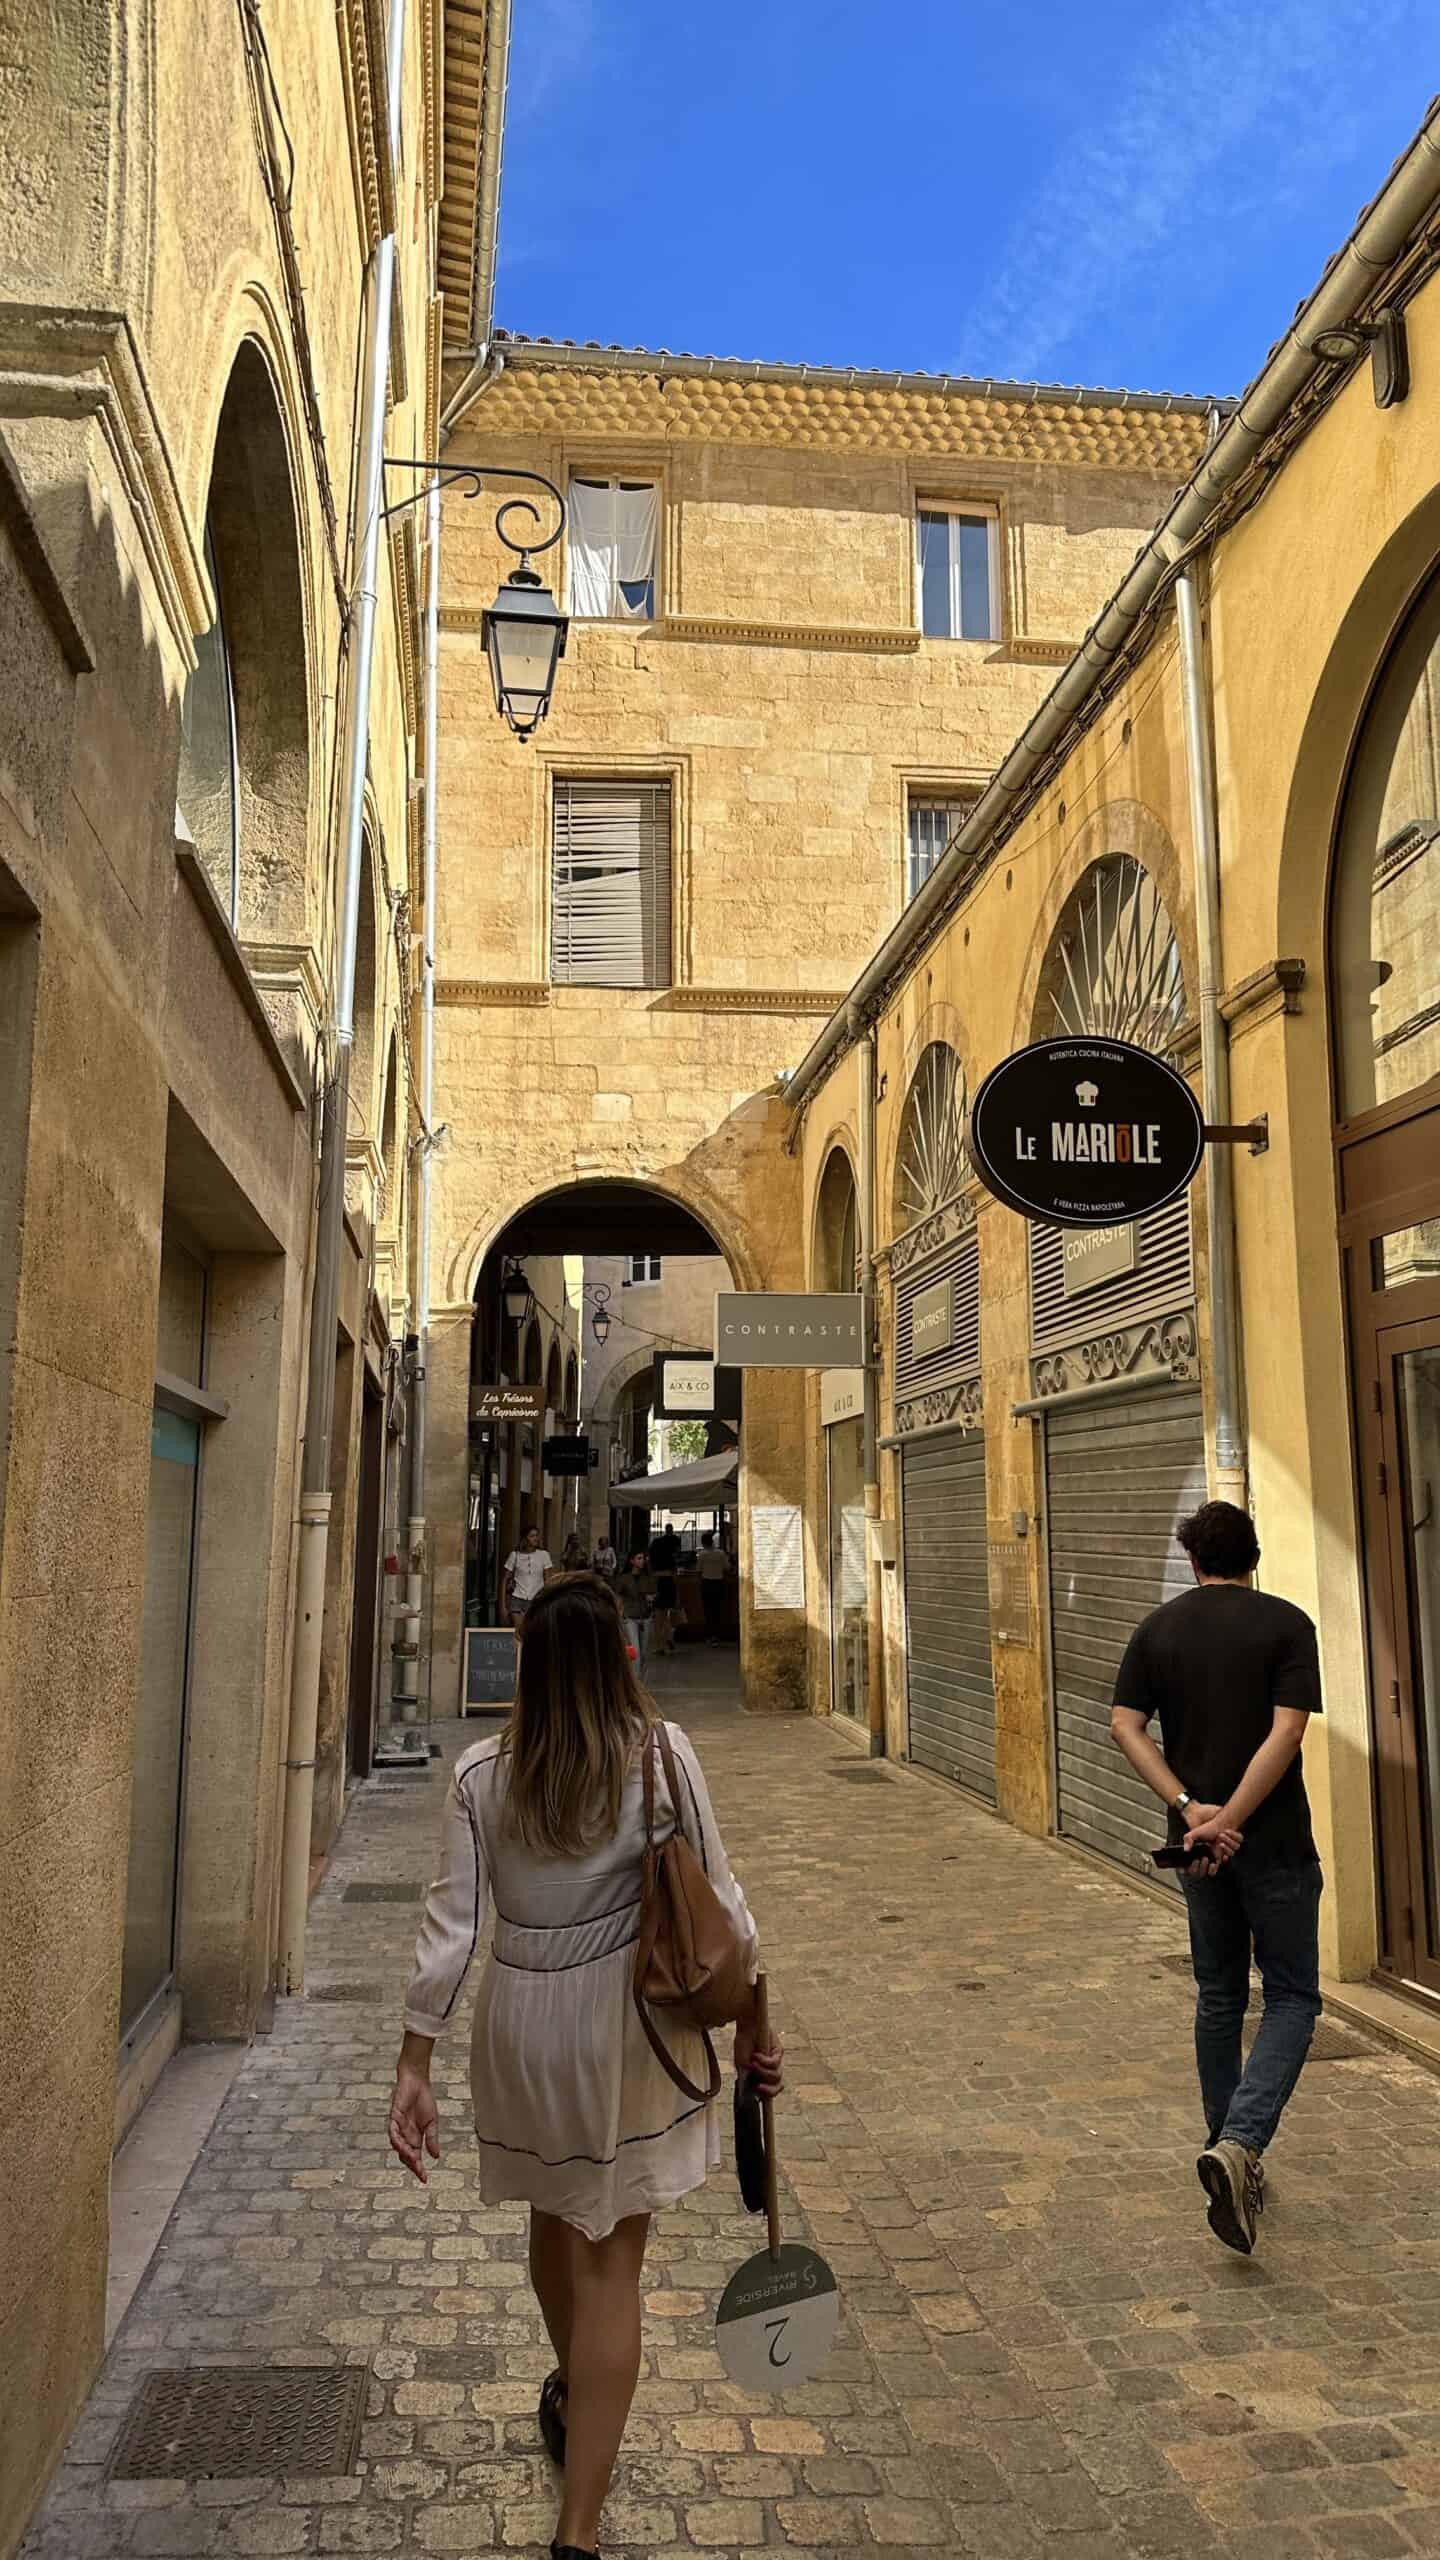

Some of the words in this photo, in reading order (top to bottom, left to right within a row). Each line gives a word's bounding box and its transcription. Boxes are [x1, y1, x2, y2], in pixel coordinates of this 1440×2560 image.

[725, 1324, 857, 1337] CONTRASTE
[735, 2279, 798, 2305] RIVERSIDE
[764, 2316, 792, 2367] 2
